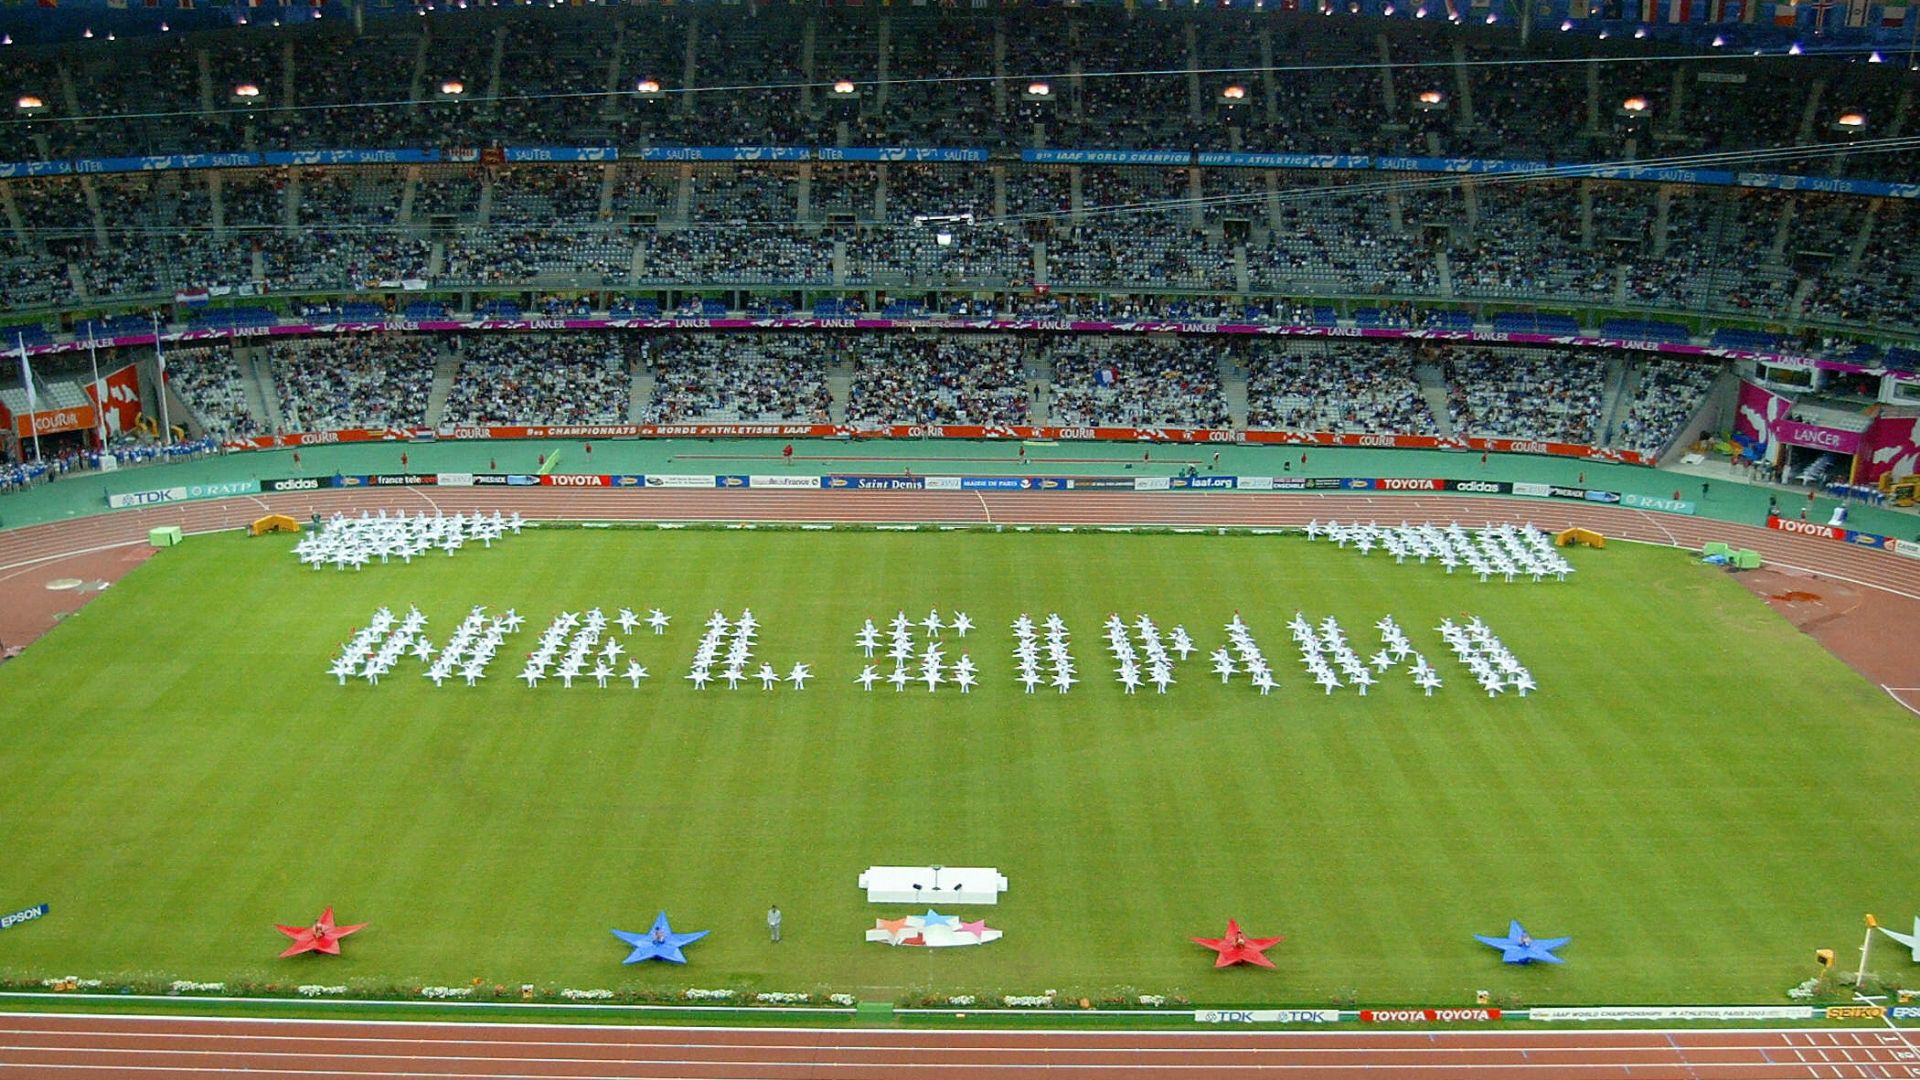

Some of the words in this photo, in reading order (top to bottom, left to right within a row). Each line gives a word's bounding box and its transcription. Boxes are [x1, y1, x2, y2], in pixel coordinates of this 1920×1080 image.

[360, 151, 396, 162] SAUTER
[516, 149, 551, 160] SAUTER
[667, 149, 702, 160] SAUTER
[944, 150, 980, 161] SAUTER
[1056, 152, 1084, 161] IAAF
[1087, 152, 1127, 162] WORLD
[1248, 155, 1310, 167] ATHLETICS
[212, 155, 250, 167] SAUTER
[1382, 159, 1419, 170] SAUTER
[1657, 169, 1697, 183] SAUTER
[1812, 179, 1854, 193] SAUTER
[384, 320, 420, 331] LANCER
[531, 319, 567, 330] LANCER
[675, 318, 711, 329] LANCER
[821, 318, 857, 329] LANCER
[1037, 320, 1073, 331] LANCER
[1182, 323, 1218, 334] LANCER
[234, 326, 271, 337] LANCER
[1327, 326, 1364, 337] LANCER
[1473, 331, 1509, 342] LANCER
[76, 337, 116, 350] LANCER
[1621, 339, 1660, 353] LANCER
[1777, 354, 1816, 369] LANCER
[36, 412, 79, 430] COURIR
[455, 427, 492, 439] COURIR
[547, 425, 638, 437] CHAMPIONNATS
[656, 426, 697, 435] MONDE
[783, 425, 812, 435] IAAF
[1059, 427, 1096, 440] COURIR
[1209, 430, 1246, 443] COURIR
[301, 431, 340, 445] COURIR
[1358, 435, 1396, 448] COURIR
[1794, 428, 1840, 448] LANCER
[1509, 440, 1548, 454] COURIR
[274, 477, 318, 491] adidas
[377, 475, 404, 486] france
[550, 474, 602, 486] TOYOTA
[858, 478, 889, 489] Saint
[892, 478, 923, 489] Denis
[1191, 478, 1233, 490] iaaf.org
[1384, 479, 1435, 491] TOYOTA
[207, 482, 253, 496] RATP
[1457, 480, 1500, 493] adidas
[134, 488, 173, 505] TDK
[1639, 495, 1687, 512] RATP
[1777, 518, 1834, 539] TOYOTA
[1, 906, 42, 928] EPSON
[1219, 1011, 1254, 1021] TDK
[1288, 1011, 1325, 1021] TDK
[1370, 1010, 1426, 1021] TOYOTA
[1434, 1009, 1490, 1020] TOYOTA
[1572, 1010, 1599, 1018] WORLD
[1828, 1007, 1882, 1018] SEIKO
